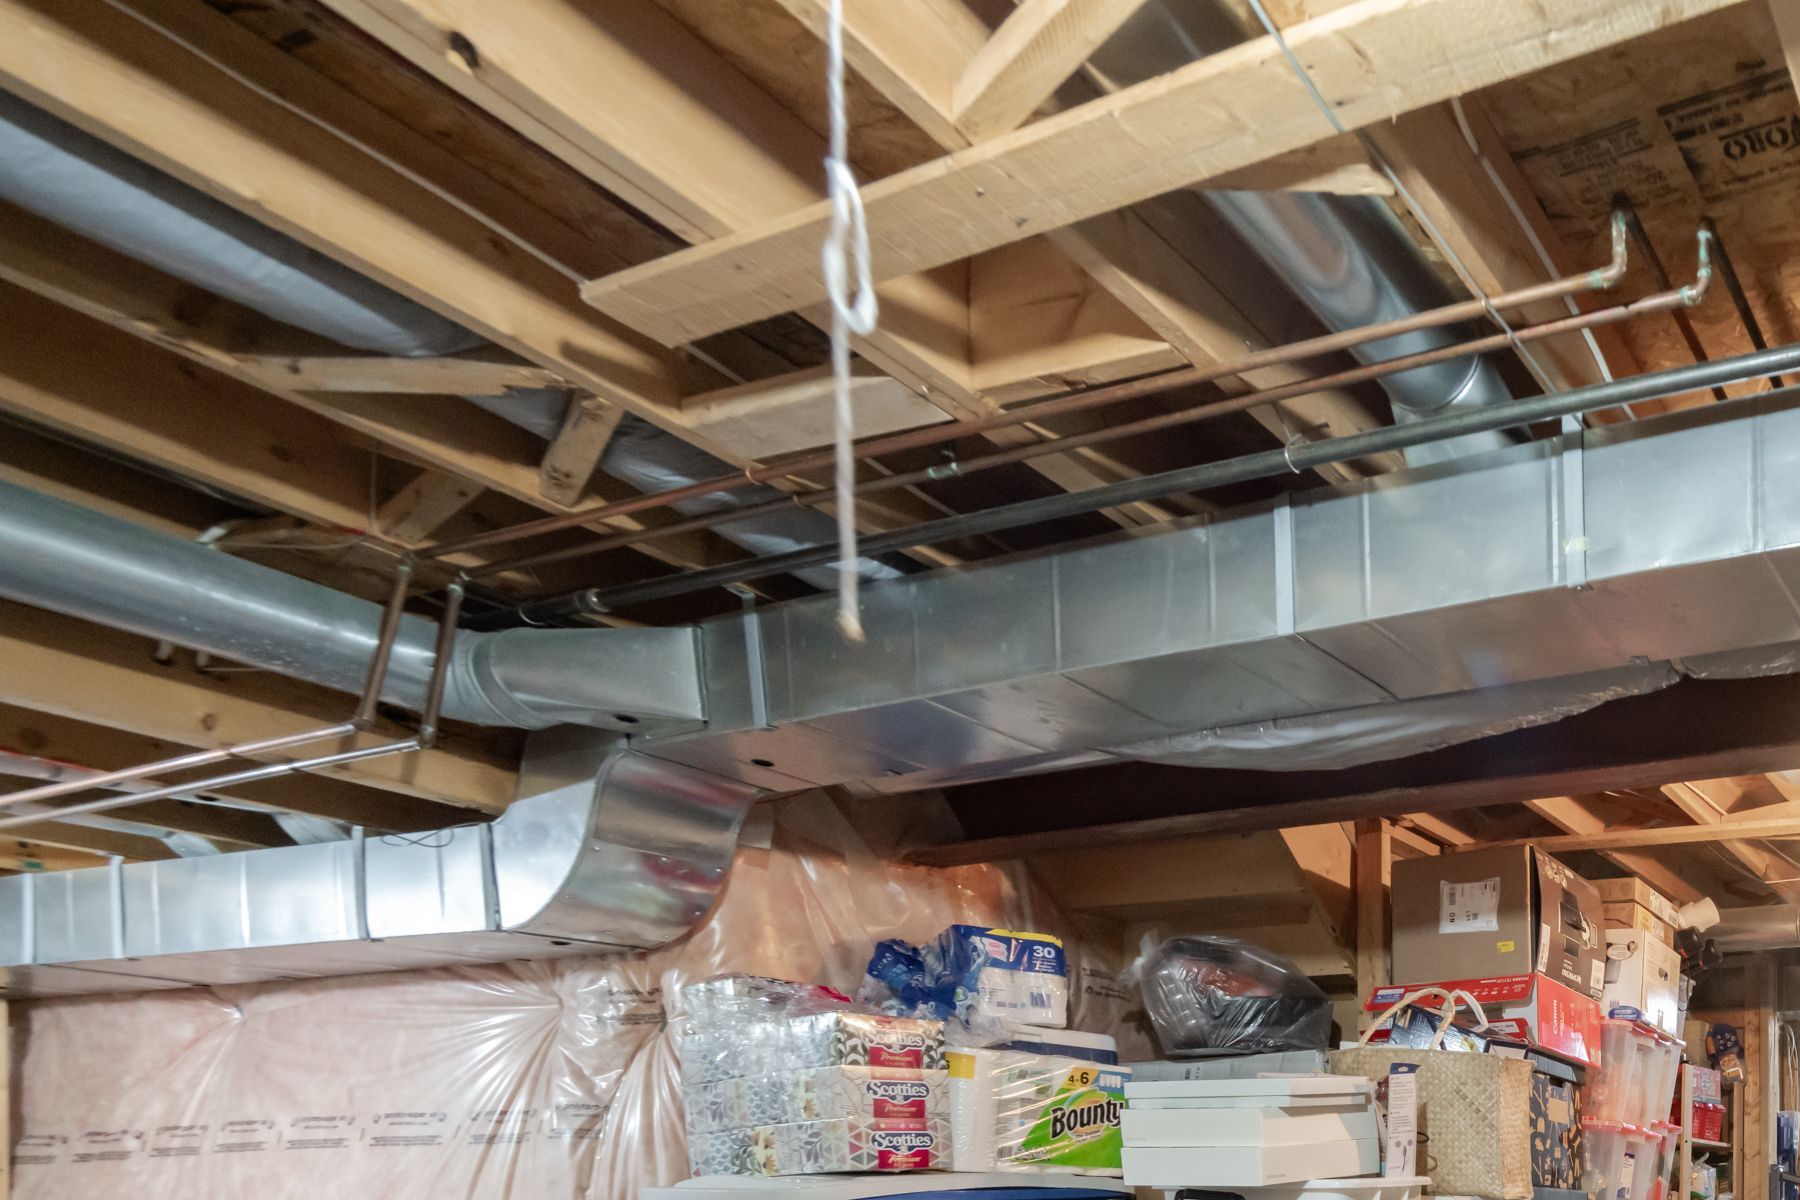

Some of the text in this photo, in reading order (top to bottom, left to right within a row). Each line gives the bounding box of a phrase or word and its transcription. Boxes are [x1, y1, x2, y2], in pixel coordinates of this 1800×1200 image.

[1032, 945, 1056, 959] 30
[869, 1082, 927, 1097] Scotties
[1050, 1099, 1124, 1139] Bounty
[873, 1132, 933, 1148] Scotties
